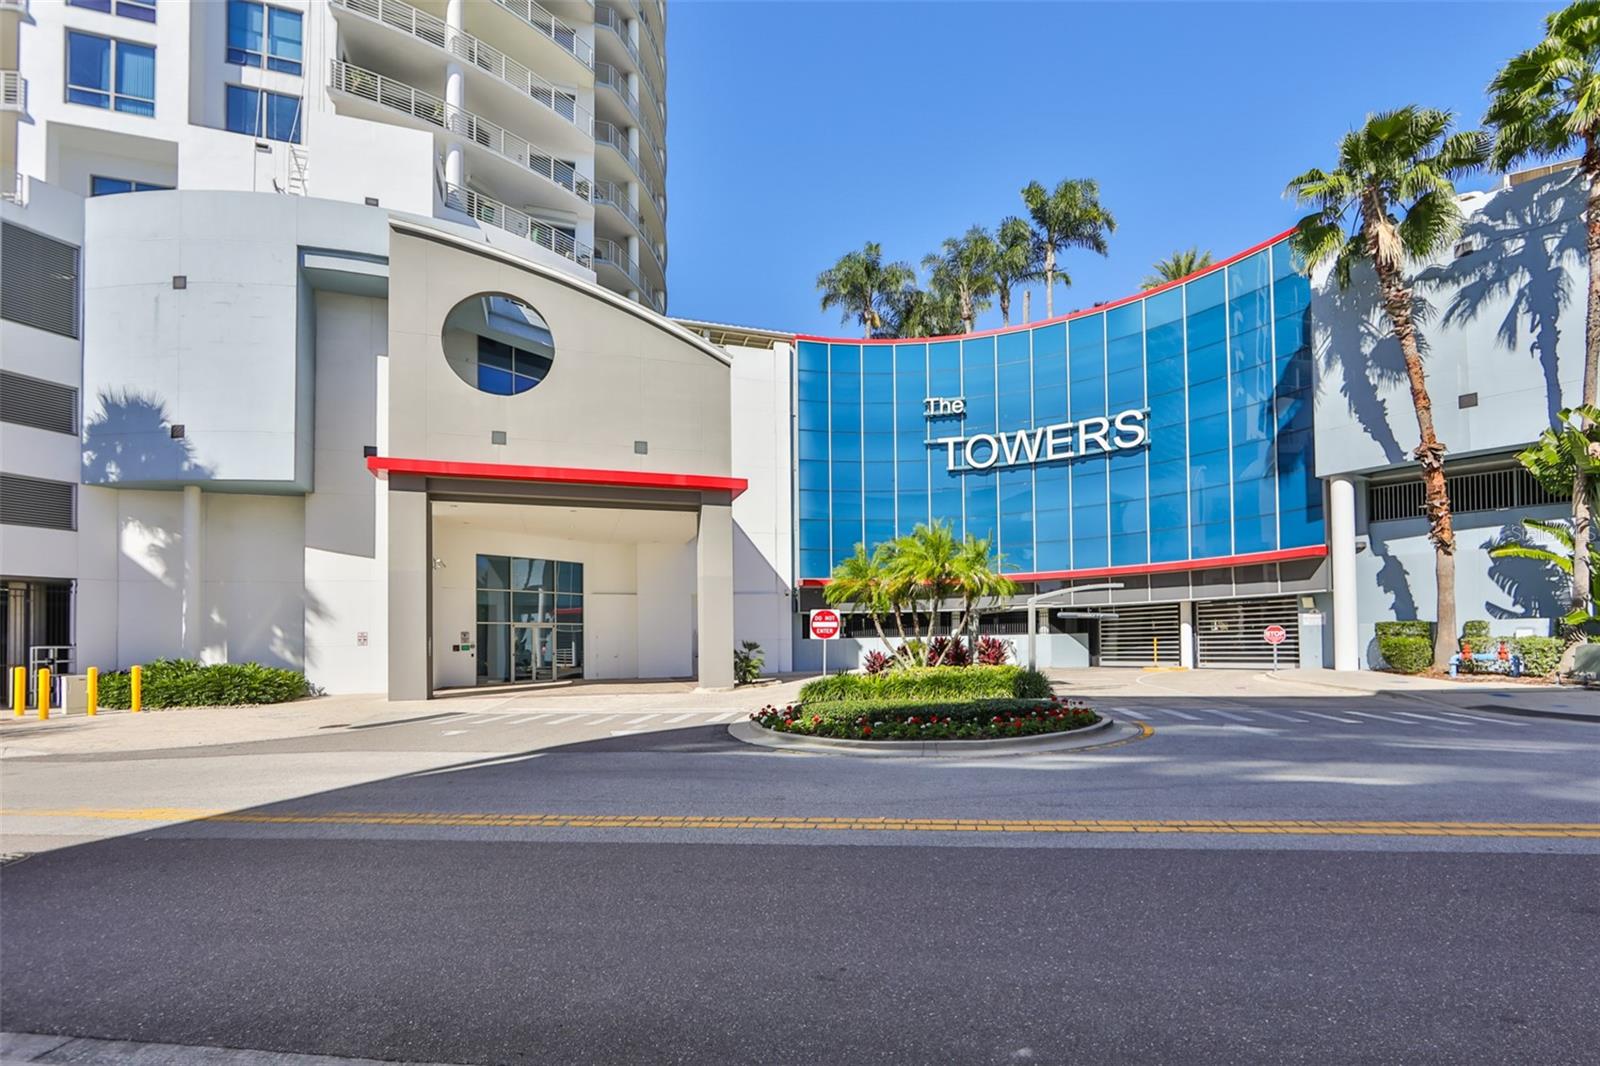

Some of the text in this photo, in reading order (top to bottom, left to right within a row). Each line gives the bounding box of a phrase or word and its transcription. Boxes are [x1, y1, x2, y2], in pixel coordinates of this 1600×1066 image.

[926, 397, 965, 414] The
[937, 409, 1146, 470] TOWERS
[1264, 630, 1286, 638] STOP
